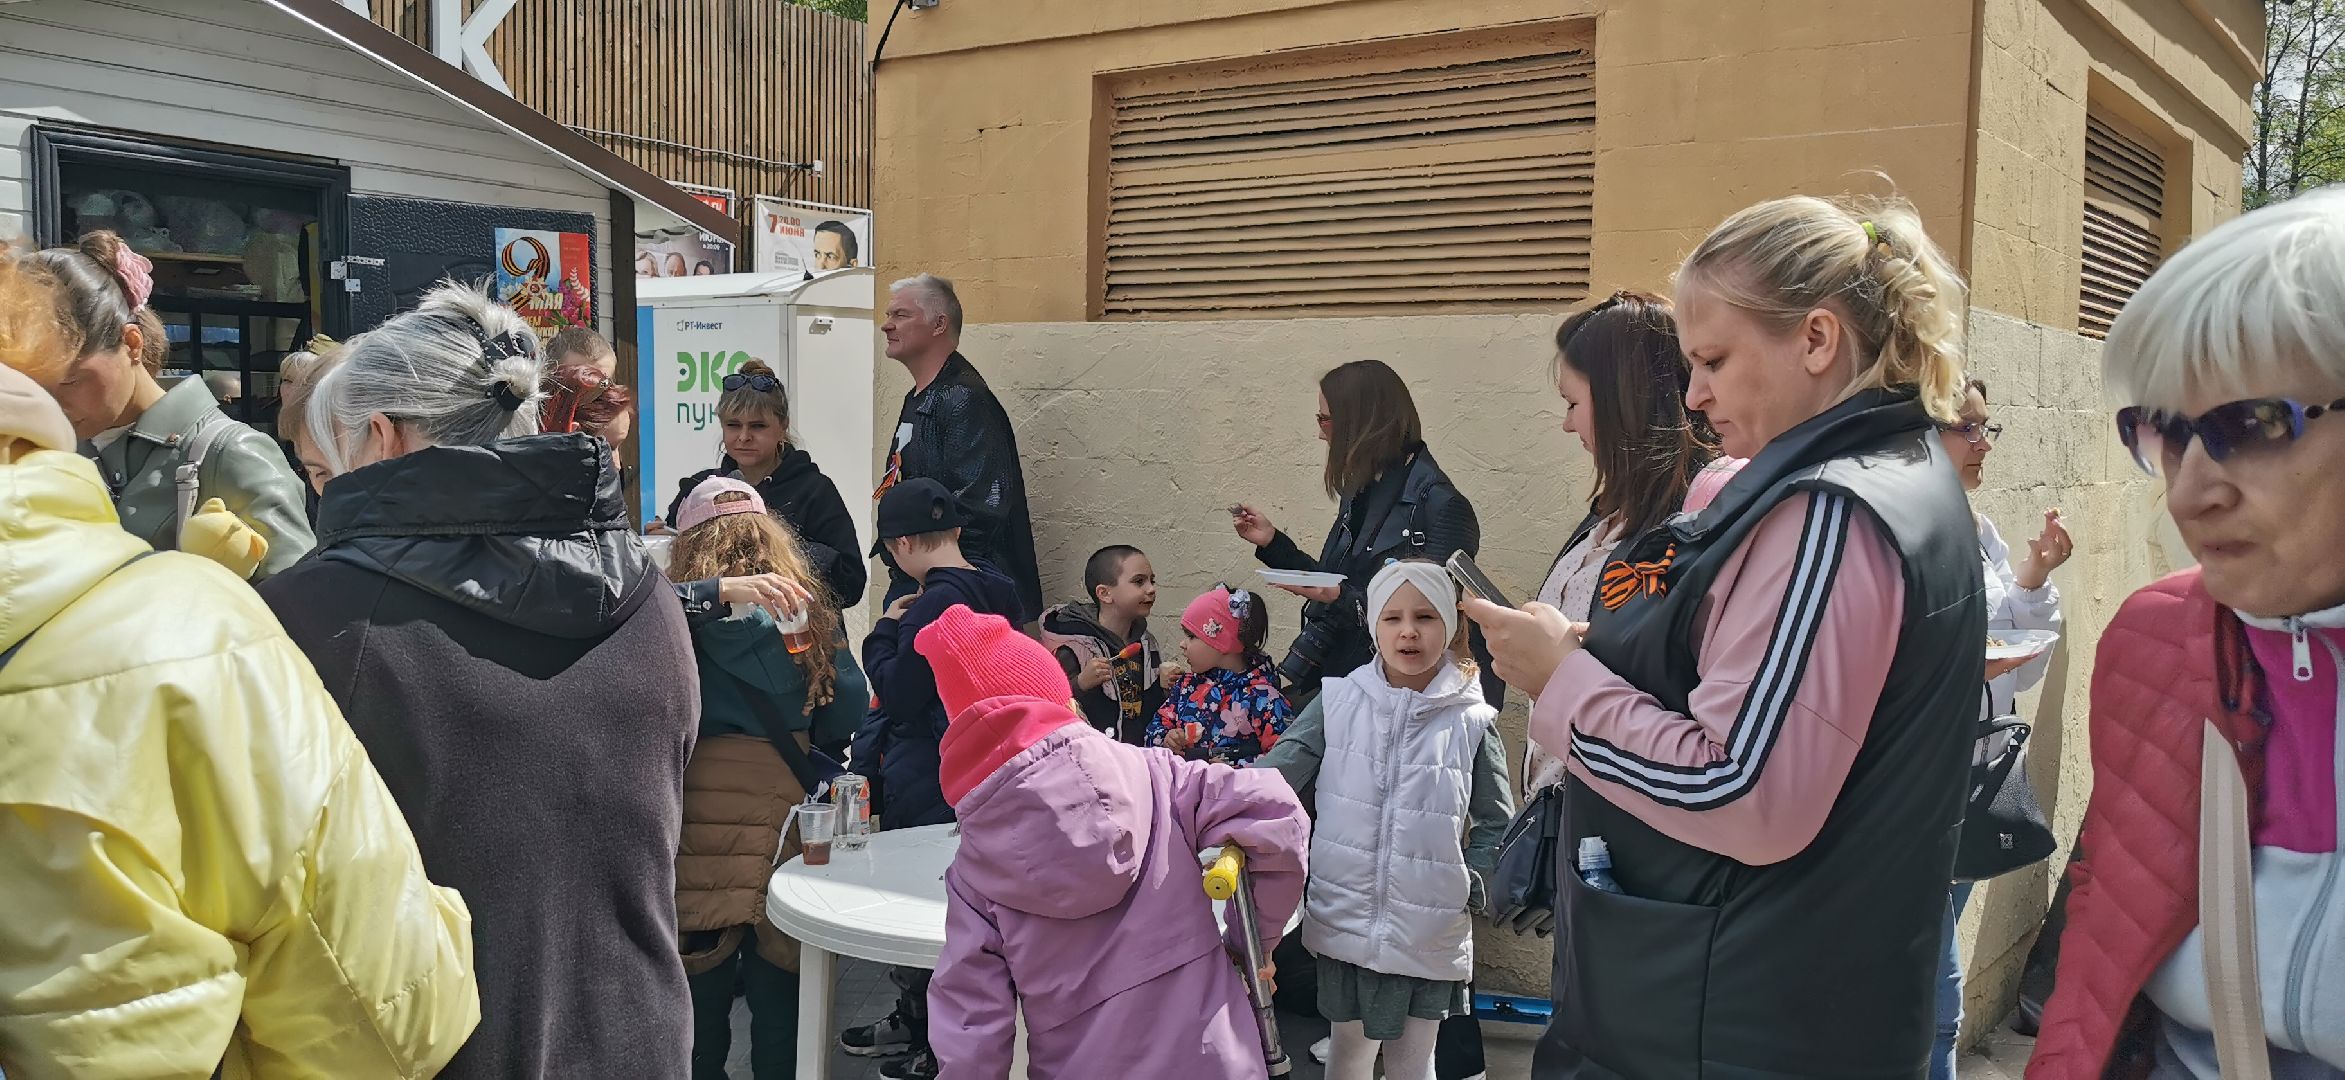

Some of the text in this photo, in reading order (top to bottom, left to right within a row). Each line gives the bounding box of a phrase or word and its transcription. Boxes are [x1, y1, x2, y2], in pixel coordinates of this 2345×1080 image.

[768, 213, 778, 233] 7
[780, 225, 805, 237] ИЮНЯ
[529, 292, 564, 310] МАЯ
[684, 320, 723, 331] РТ-Инвест
